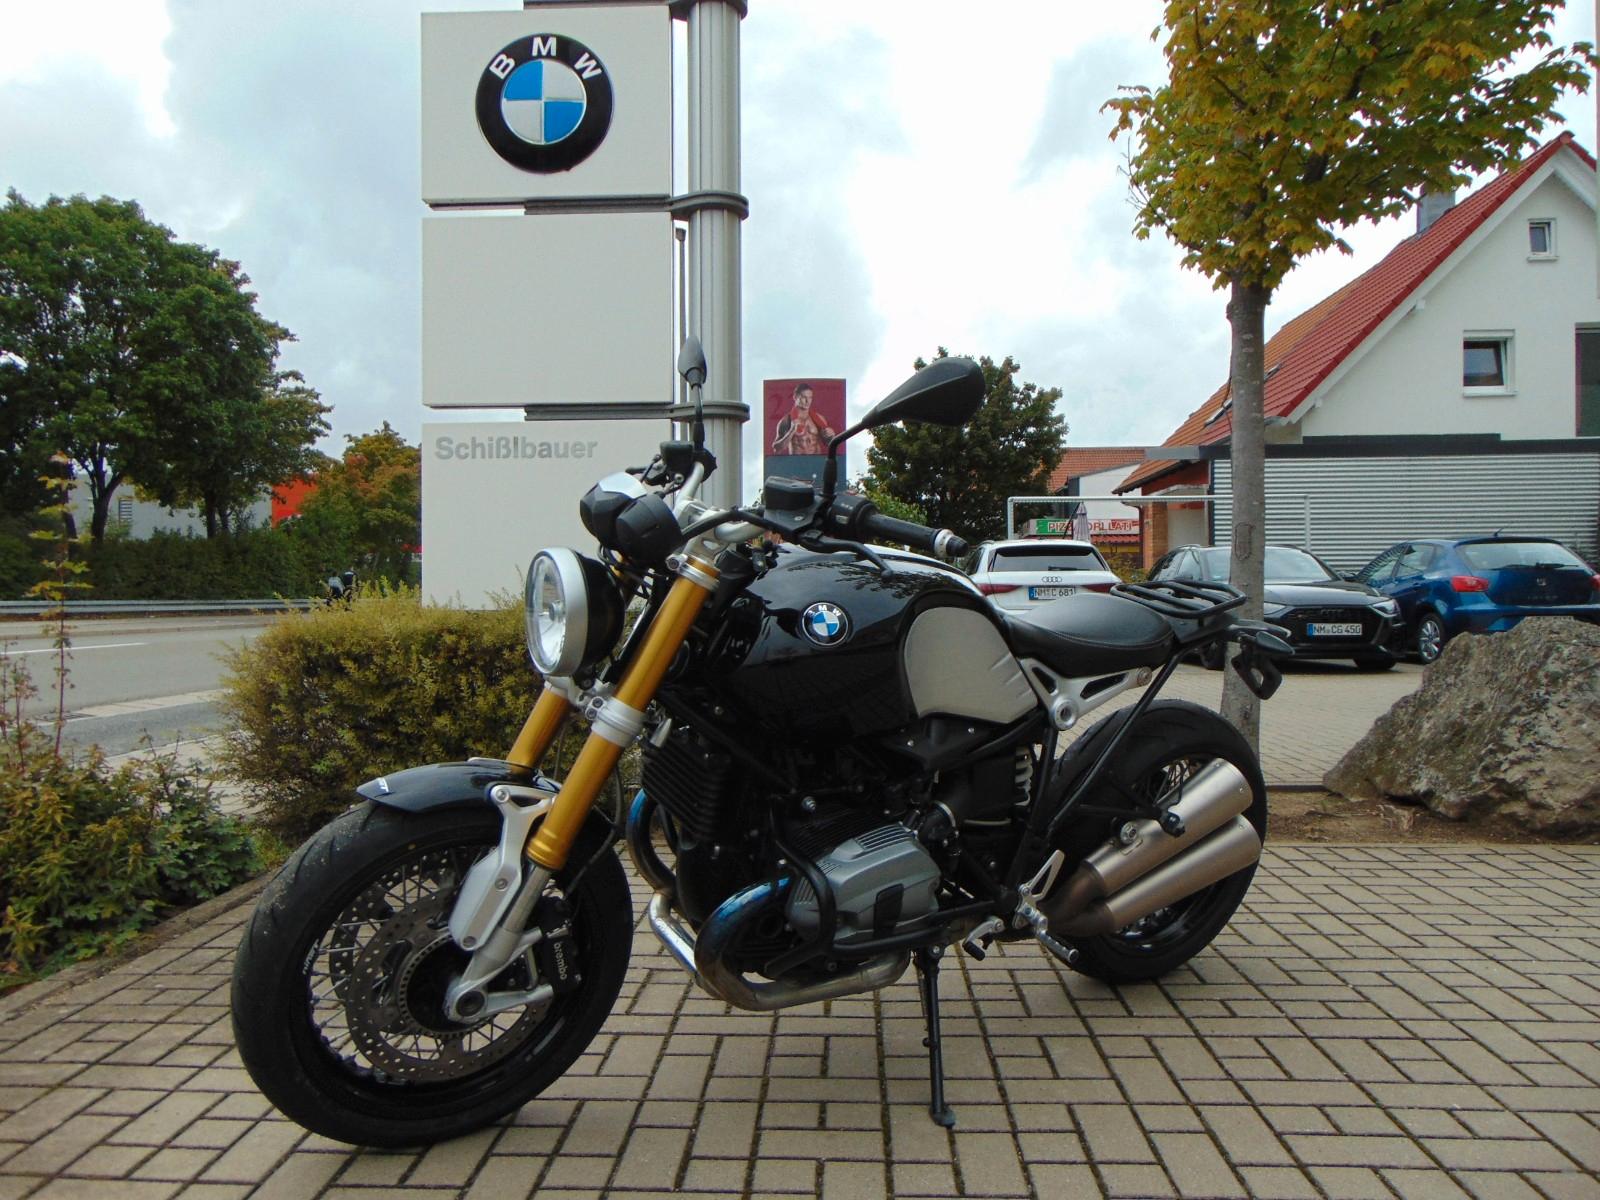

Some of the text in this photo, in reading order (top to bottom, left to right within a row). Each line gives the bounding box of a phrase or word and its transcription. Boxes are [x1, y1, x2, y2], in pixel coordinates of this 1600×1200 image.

[488, 36, 603, 80] BMW
[434, 436, 599, 459] Schißlbauer
[807, 604, 841, 617] BMW
[553, 941, 568, 981] brembo
